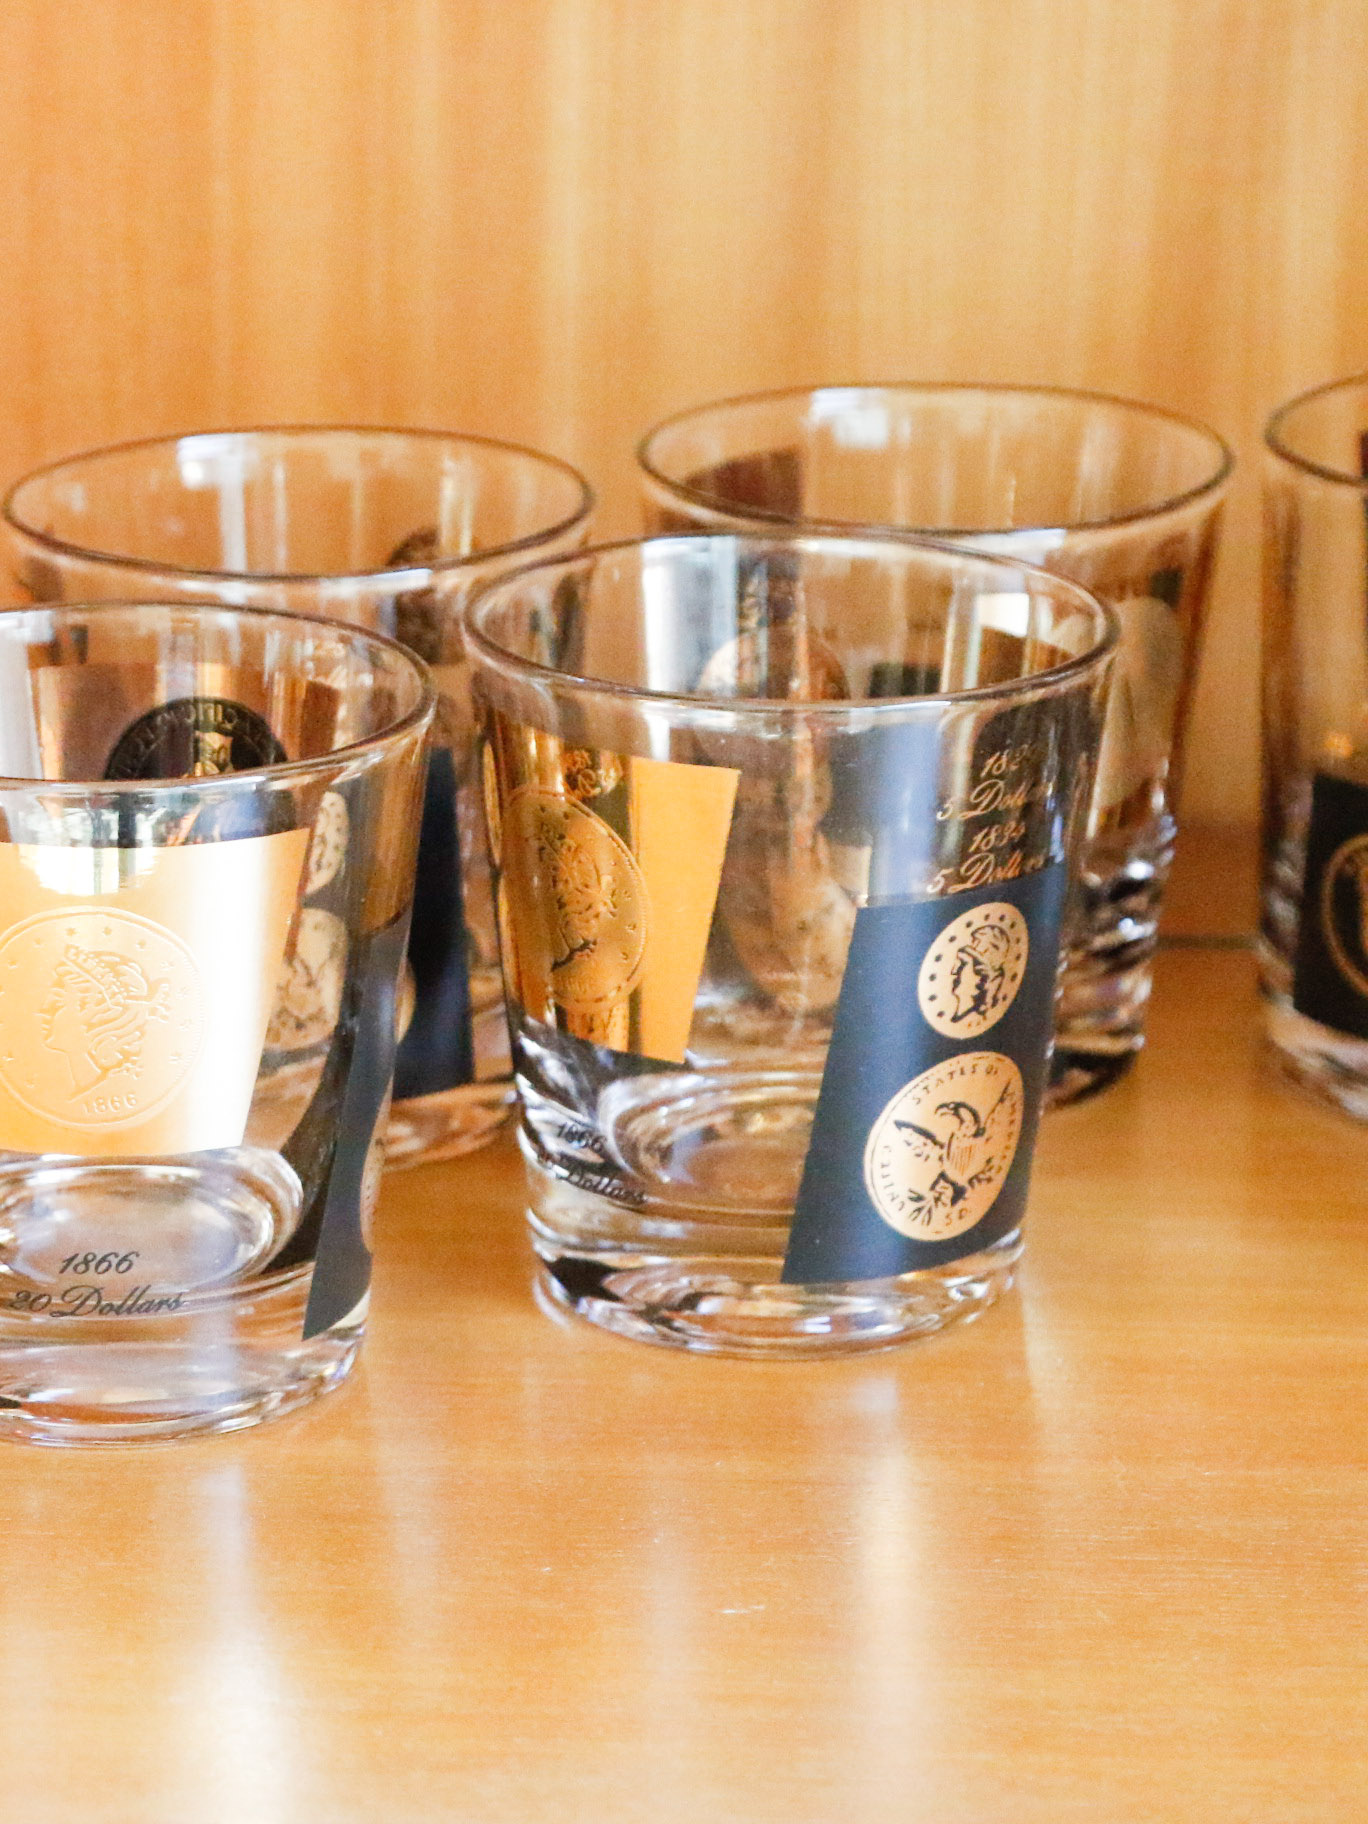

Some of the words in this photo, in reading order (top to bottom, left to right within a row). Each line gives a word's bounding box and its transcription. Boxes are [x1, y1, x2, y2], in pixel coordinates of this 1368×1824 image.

[926, 867, 955, 893] 5
[80, 1091, 137, 1117] 1866
[58, 1250, 140, 1276] 1866
[8, 1289, 52, 1313] 20
[49, 1284, 187, 1319] Dollars
